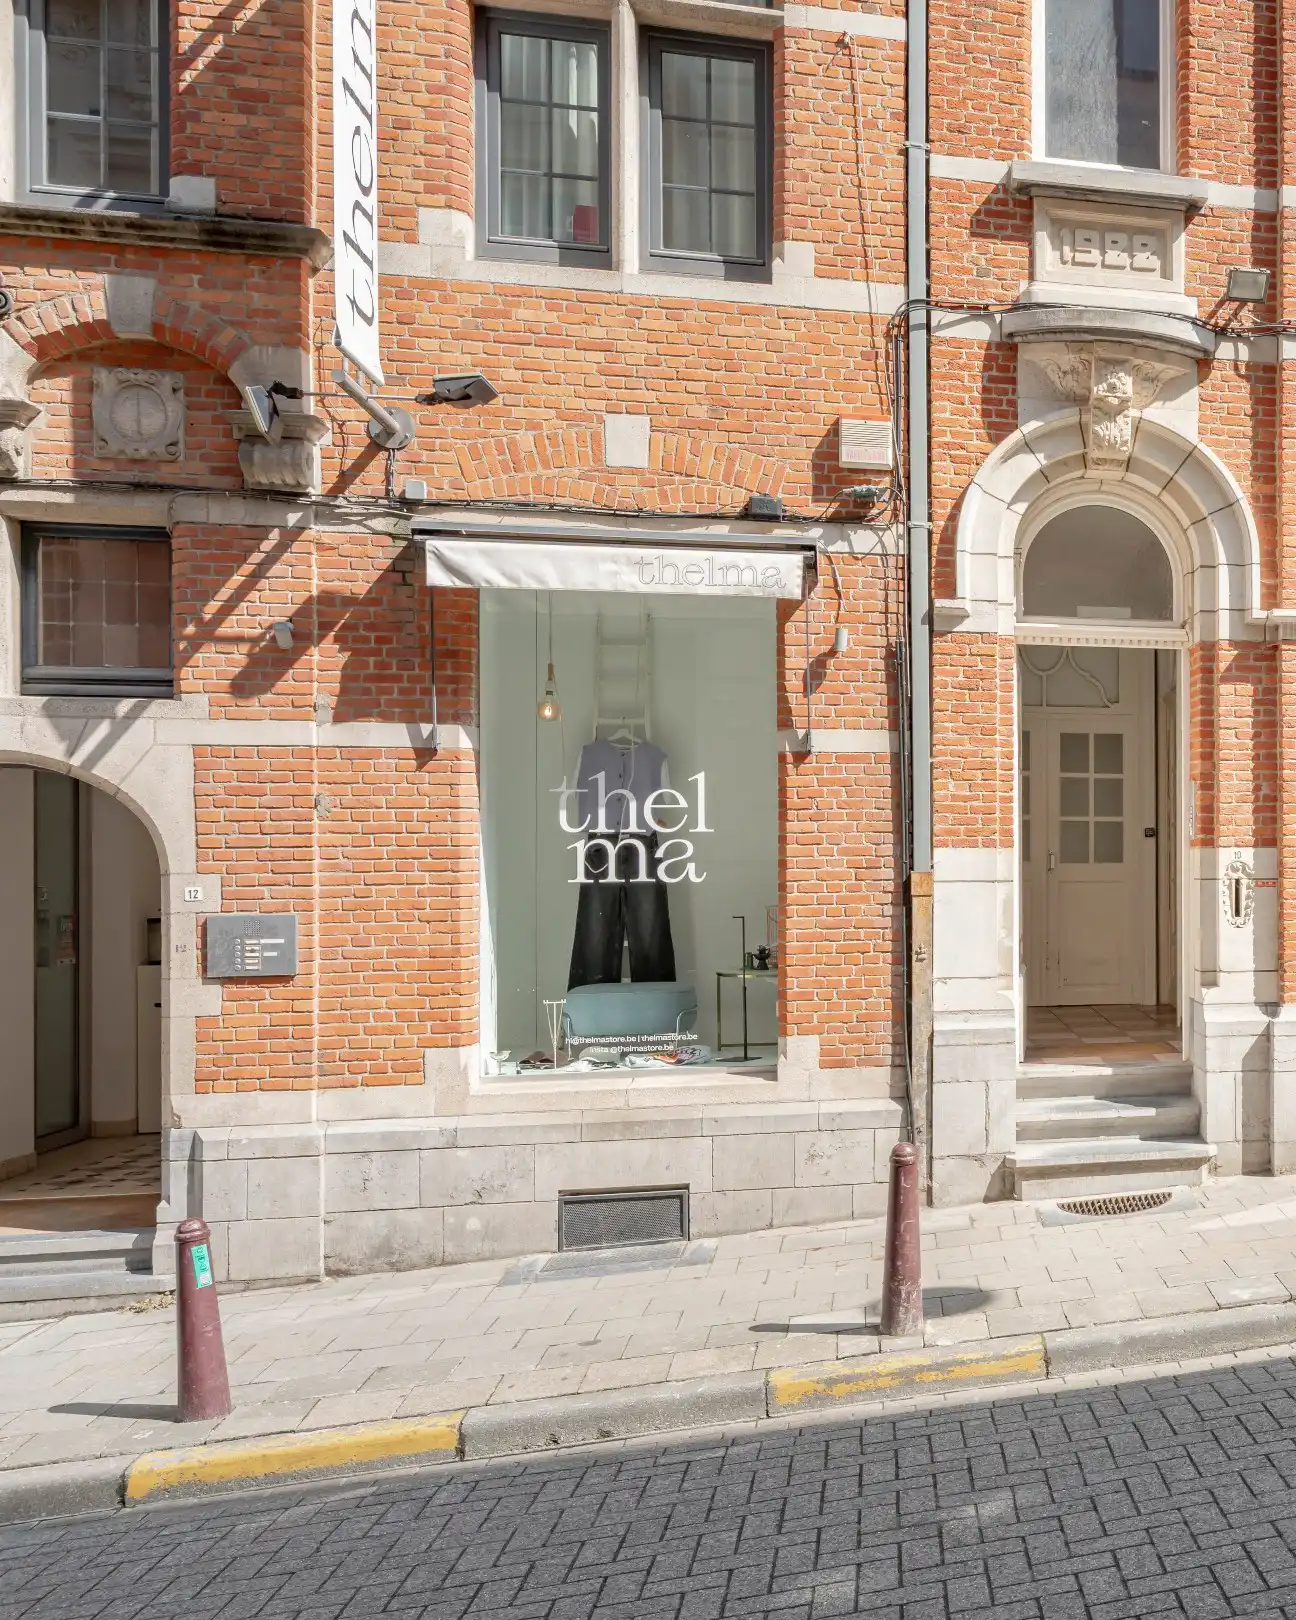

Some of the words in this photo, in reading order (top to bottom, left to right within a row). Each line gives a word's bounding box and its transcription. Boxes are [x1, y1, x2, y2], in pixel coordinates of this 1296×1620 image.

[634, 554, 786, 589] thelma
[549, 771, 714, 833] thel
[567, 838, 707, 883] ma
[1234, 850, 1242, 860] 10
[187, 889, 199, 899] 12
[641, 1030, 698, 1042] thelmastore.be
